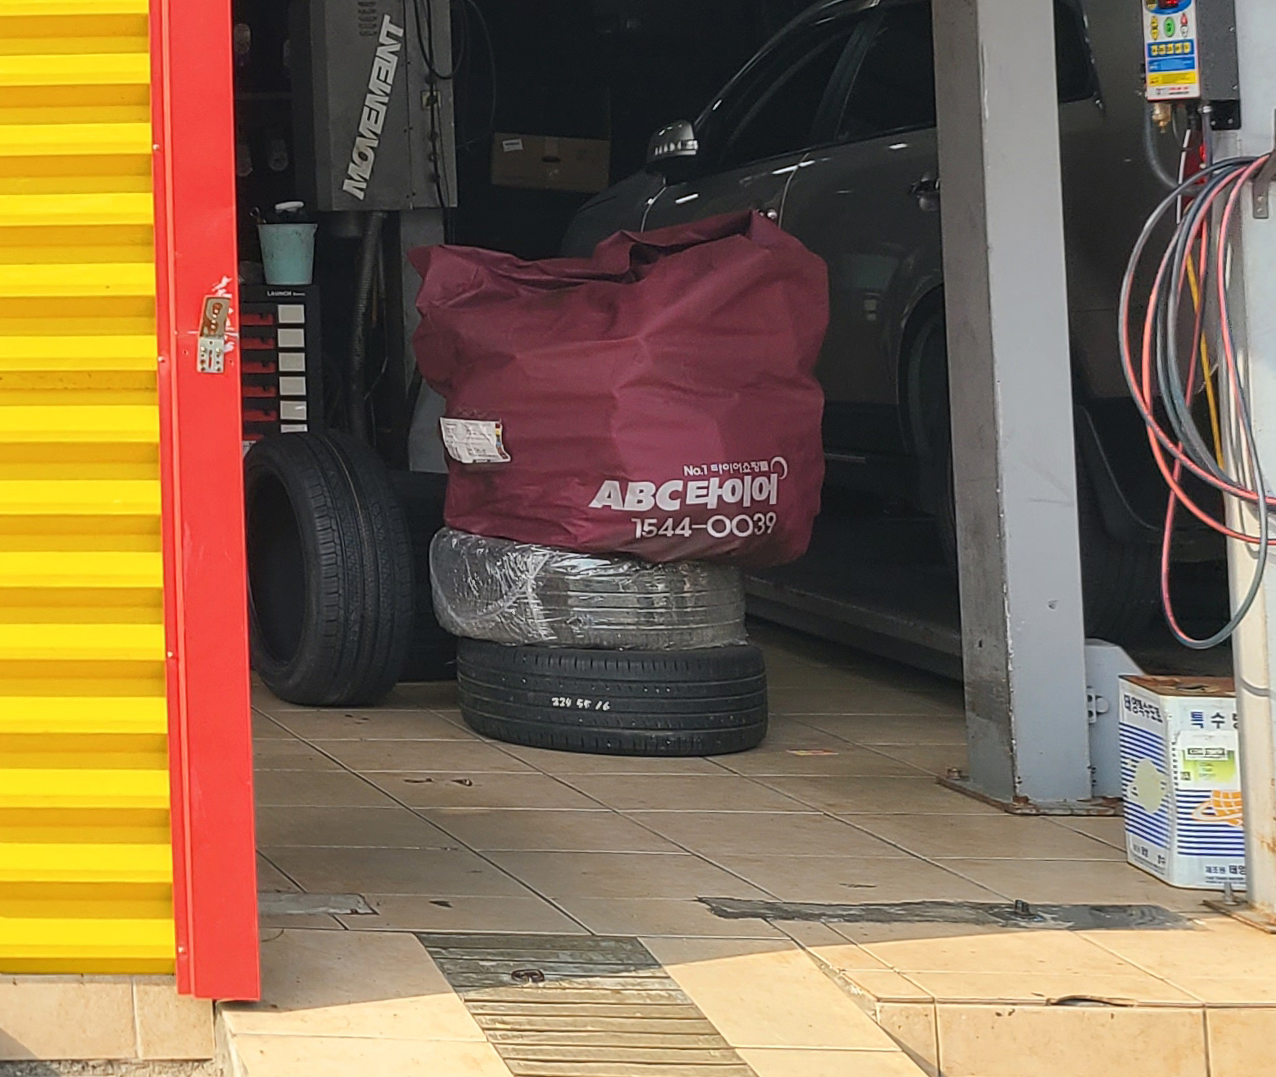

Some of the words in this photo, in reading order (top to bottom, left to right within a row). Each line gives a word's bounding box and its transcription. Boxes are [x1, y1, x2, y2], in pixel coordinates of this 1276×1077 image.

[343, 14, 404, 200] MOVEMENT
[683, 465, 708, 476] No.1
[588, 473, 778, 511] ABC타이어
[631, 512, 777, 538] 1544-0039
